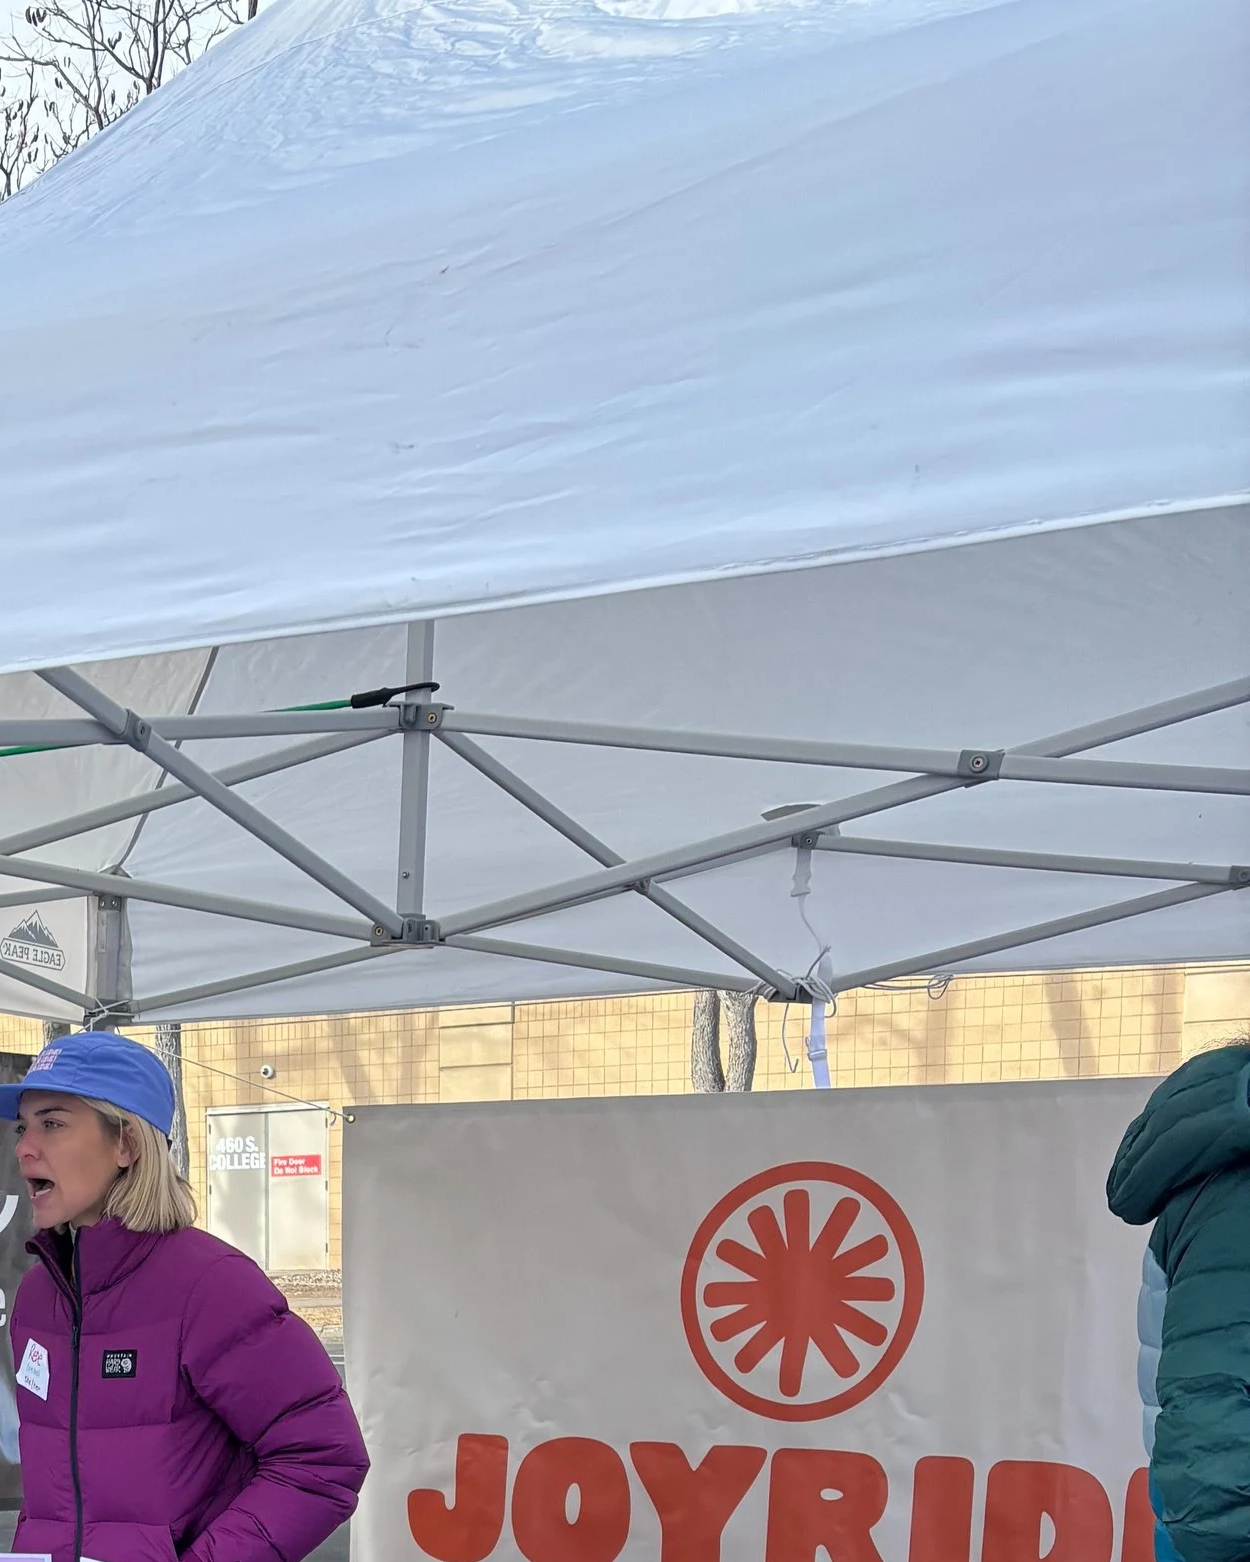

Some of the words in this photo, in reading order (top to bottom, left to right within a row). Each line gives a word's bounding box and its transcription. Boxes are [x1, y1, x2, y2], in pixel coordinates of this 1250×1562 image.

[216, 1137, 243, 1153] 460
[245, 1136, 258, 1153] S.
[209, 1152, 266, 1170] COLLEGE
[273, 1158, 287, 1166] Fire
[274, 1167, 284, 1175] Do
[285, 1166, 297, 1174] Not
[299, 1166, 318, 1174] Block
